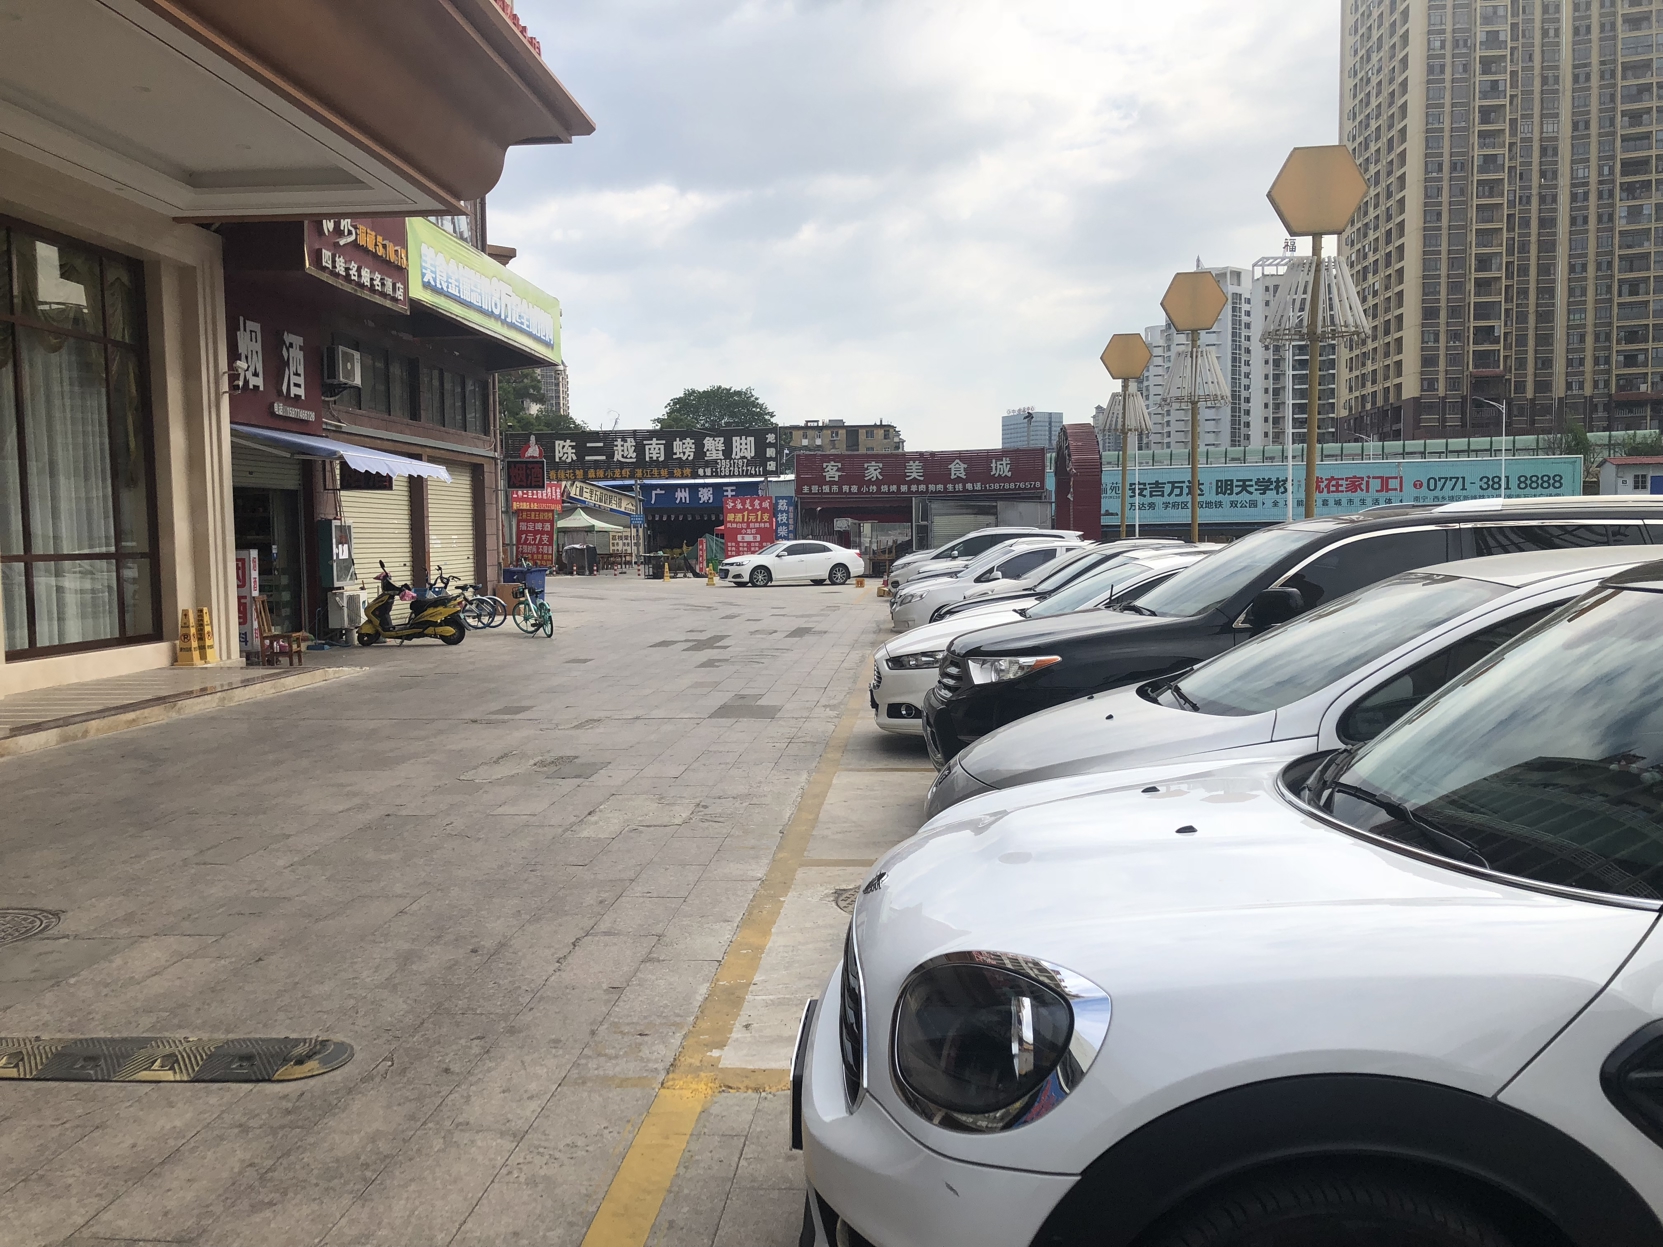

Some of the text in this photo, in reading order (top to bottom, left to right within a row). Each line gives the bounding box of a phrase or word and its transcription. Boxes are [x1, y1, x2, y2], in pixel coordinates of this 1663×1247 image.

[1282, 238, 1296, 252] 福
[322, 248, 404, 300] 四娃名烟名酒店
[237, 315, 305, 400] 烟酒
[555, 435, 755, 463] 陈二越南螃蟹脚
[717, 459, 747, 468] 3951797
[823, 457, 1012, 481] 客家美食城
[510, 464, 543, 486] 烟酒
[1517, 474, 1564, 490] 8888
[910, 484, 926, 492] 羊肉
[965, 481, 1041, 490] 电话:13878876578
[1128, 479, 1205, 498] 安吉万达
[1215, 477, 1293, 496] 明天学校
[1128, 501, 1156, 511] 万达旁
[1162, 500, 1189, 510] 学府区
[1229, 499, 1257, 508] 双公园
[727, 511, 770, 522] 啤酒1元1支
[777, 499, 788, 541] 荔枝柴
[519, 522, 551, 531] 指定啤酒
[521, 534, 549, 544] 1元1支
